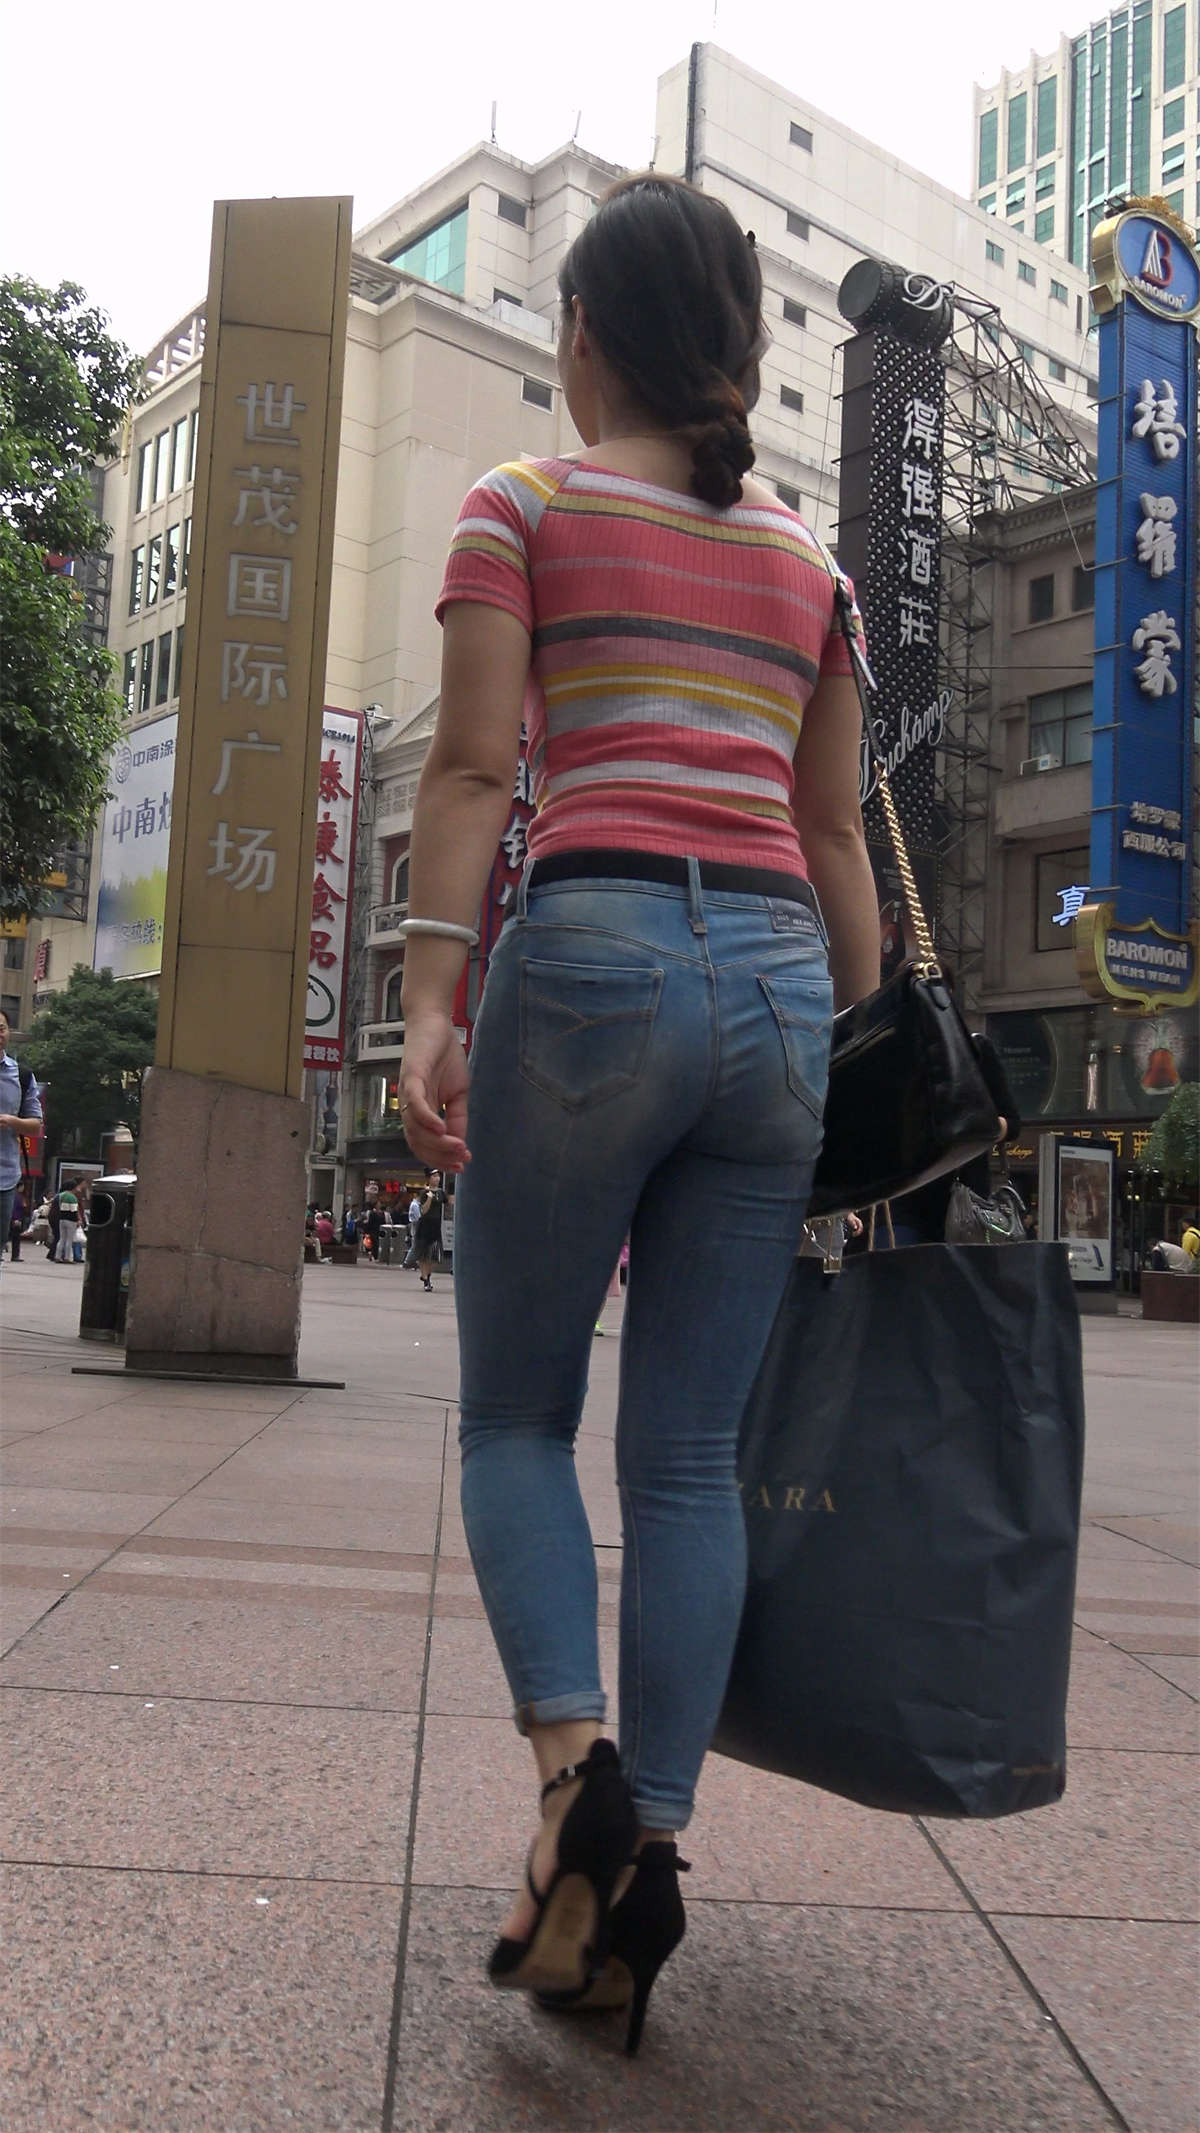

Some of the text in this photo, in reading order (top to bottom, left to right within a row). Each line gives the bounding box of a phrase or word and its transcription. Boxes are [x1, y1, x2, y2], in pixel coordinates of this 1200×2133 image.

[206, 381, 307, 893] 世茂国际广场
[1106, 937, 1188, 970] BAROMON
[739, 1483, 838, 1513] ARA
